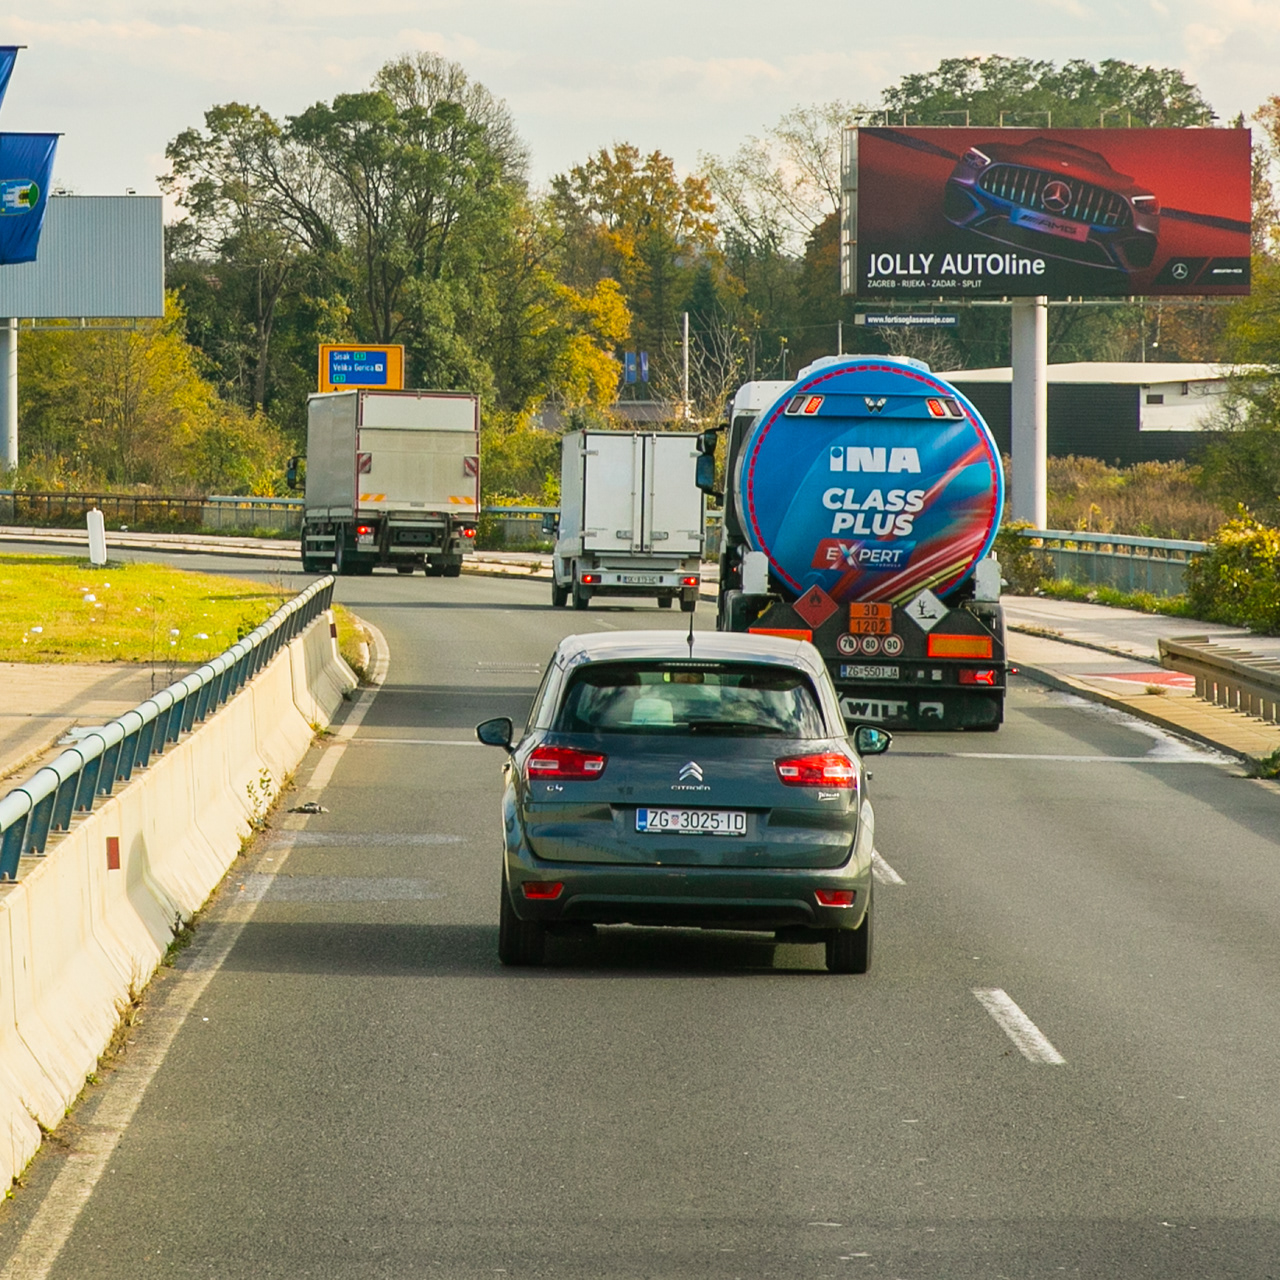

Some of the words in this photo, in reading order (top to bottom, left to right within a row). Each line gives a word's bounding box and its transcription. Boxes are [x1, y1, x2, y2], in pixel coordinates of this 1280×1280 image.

[867, 253, 934, 278] JOLLY
[940, 253, 1046, 275] AUTOline
[867, 279, 896, 288] ZAGREB
[902, 279, 926, 288] RIJEKA
[931, 280, 956, 288] ZADAR
[962, 280, 982, 288] SPLIT
[333, 352, 350, 361] Sisak
[333, 363, 352, 371] Velika
[354, 363, 374, 371] Gorica
[822, 487, 925, 513] CLASS
[831, 512, 914, 537] PLUS
[826, 542, 904, 567] EXPERT
[863, 604, 879, 616] 30
[856, 620, 887, 633] 1202
[865, 640, 876, 649] 80
[886, 640, 898, 650] 90
[848, 666, 859, 677] ZG
[649, 810, 669, 828] ZG
[680, 811, 744, 830] 3025-ID
